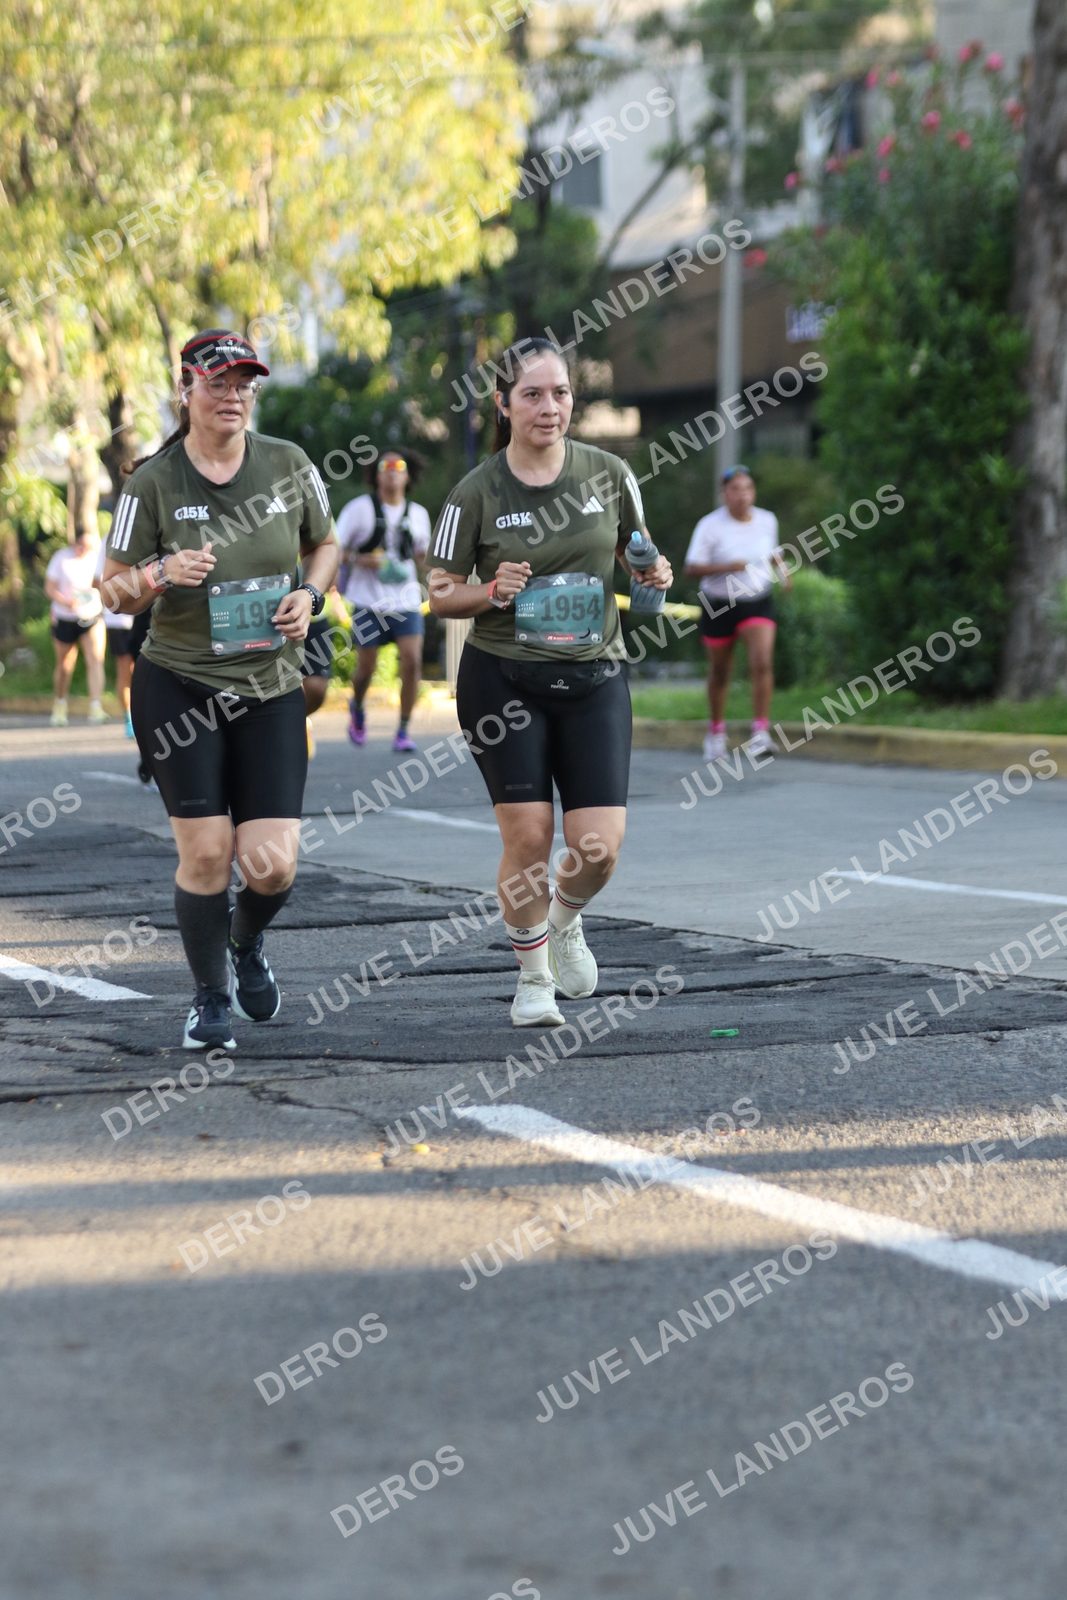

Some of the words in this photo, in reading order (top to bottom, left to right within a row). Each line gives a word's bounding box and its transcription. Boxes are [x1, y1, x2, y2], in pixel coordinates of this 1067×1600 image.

[174, 504, 209, 520] G15K
[495, 511, 532, 529] G15K
[540, 592, 601, 621] 1954
